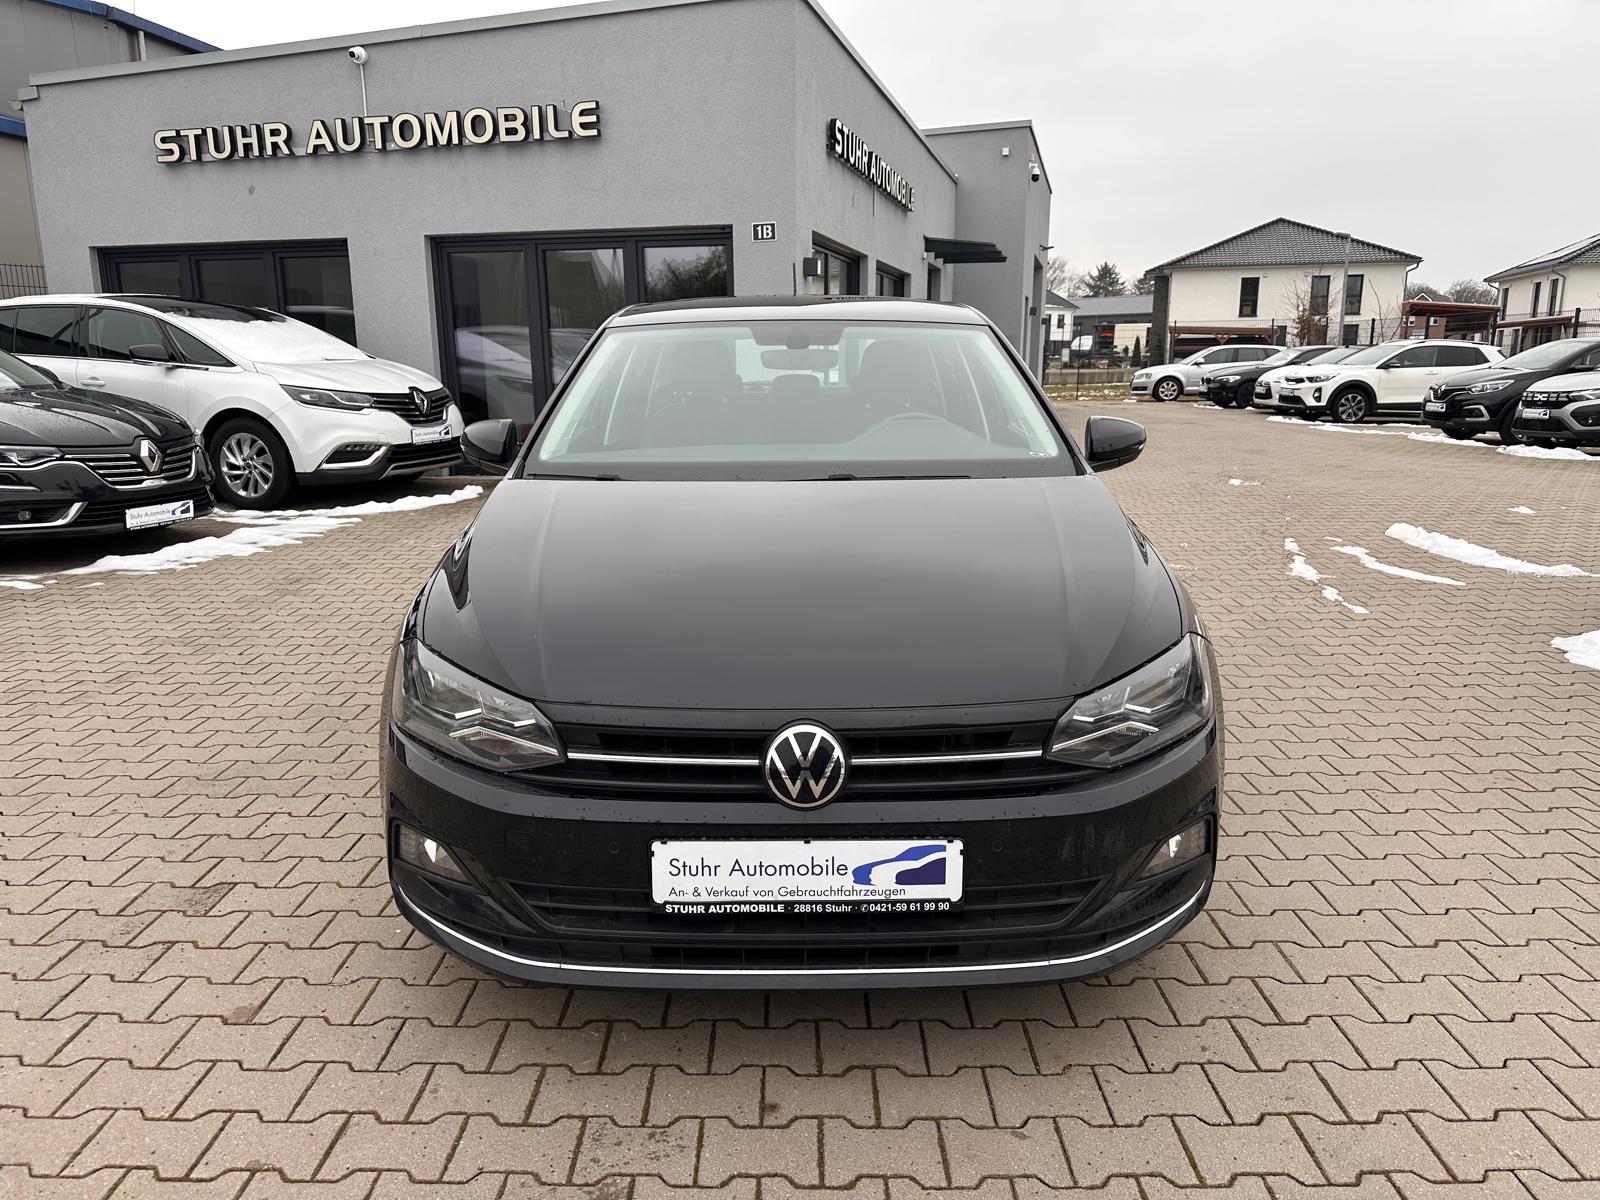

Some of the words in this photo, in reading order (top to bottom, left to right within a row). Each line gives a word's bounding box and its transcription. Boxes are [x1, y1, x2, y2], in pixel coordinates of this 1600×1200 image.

[154, 120, 295, 163] STUHR
[305, 100, 600, 155] AUTOMOBILE
[834, 118, 869, 177] STUHR
[869, 150, 914, 212] AUTOMOBILE
[755, 224, 773, 239] 1B
[668, 857, 721, 877] Stuhr
[728, 856, 849, 877] Automobile
[668, 886, 688, 897] An-
[692, 886, 702, 897] &
[705, 886, 750, 897] Verkauf
[752, 889, 774, 897] von
[777, 885, 906, 899] Gebrauchtfahrzeugen
[665, 904, 705, 913] STUHR
[708, 904, 785, 913] AUTOMOBILE
[793, 904, 823, 913] 28816
[825, 903, 853, 913] Stuhr
[909, 903, 920, 911] 61
[923, 902, 936, 911] 99
[937, 902, 950, 911] 90
